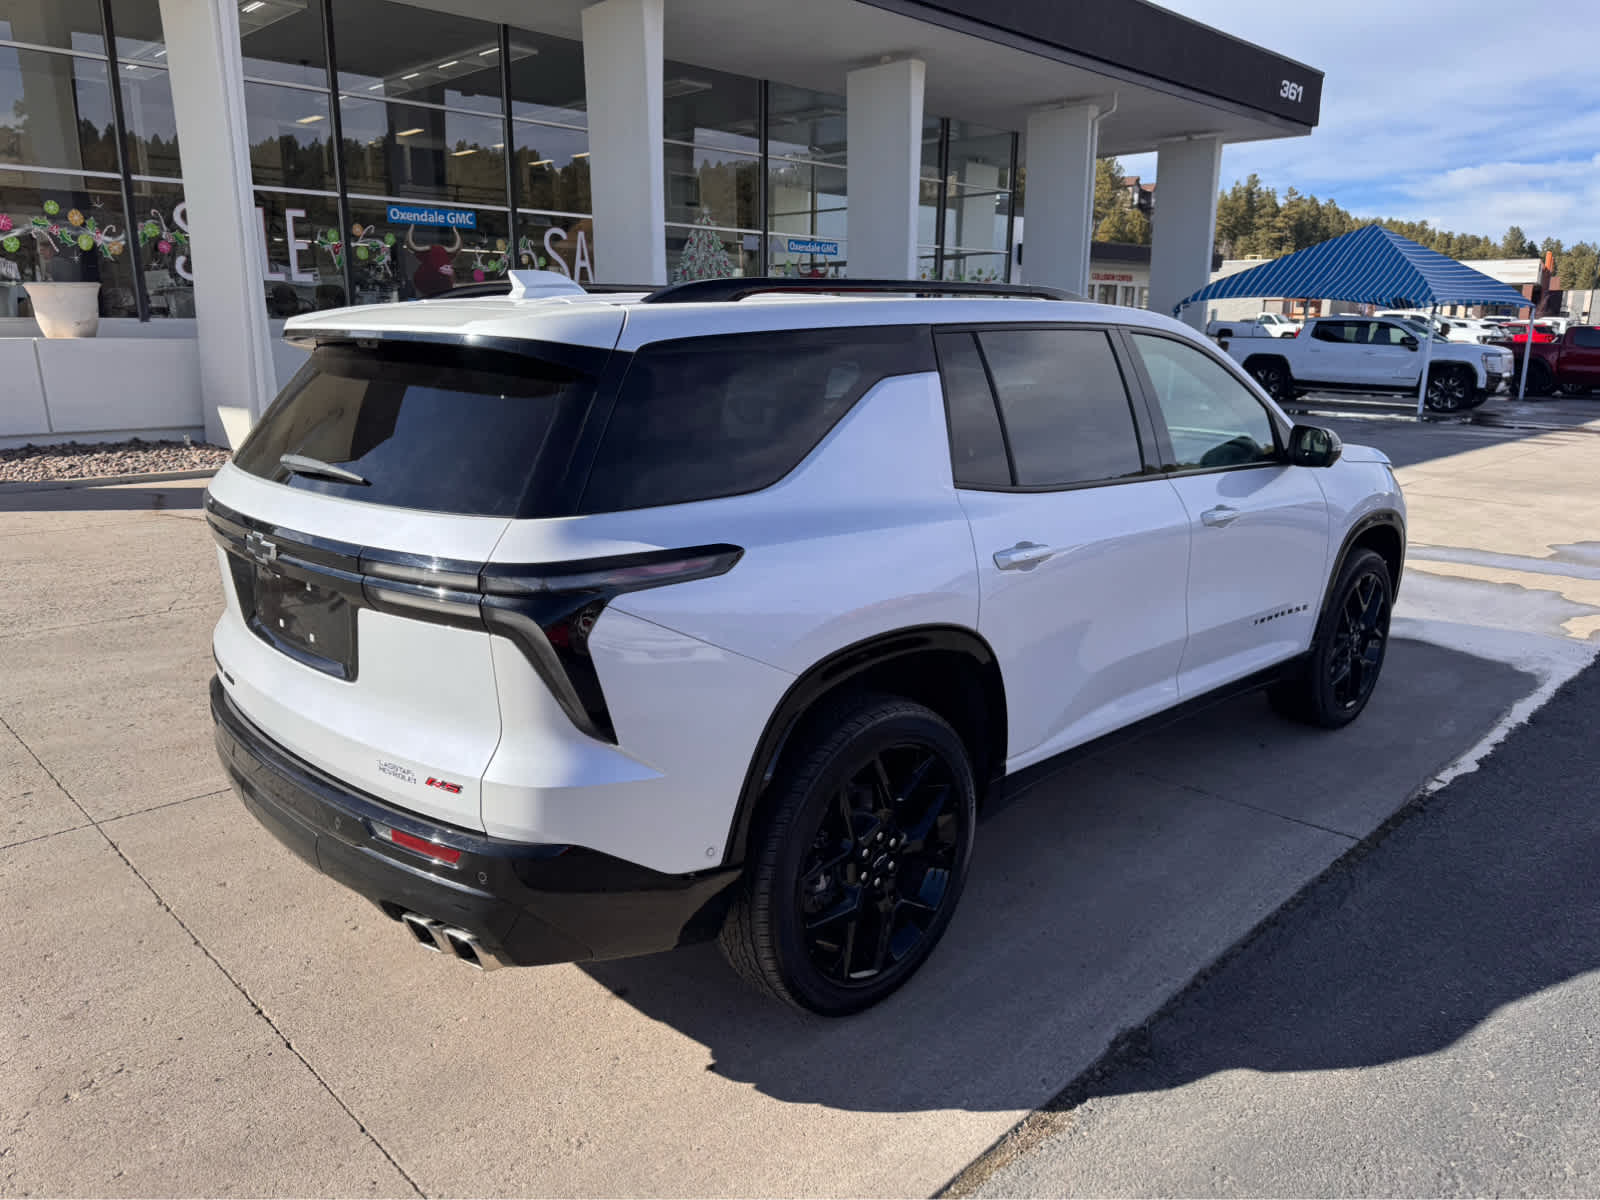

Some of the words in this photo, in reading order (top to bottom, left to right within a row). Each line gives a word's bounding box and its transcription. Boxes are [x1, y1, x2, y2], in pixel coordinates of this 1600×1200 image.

[1280, 80, 1303, 103] 361
[390, 207, 445, 224] Oxendale
[447, 212, 474, 225] GMC
[173, 202, 314, 282] SLE
[425, 777, 463, 794] RS
